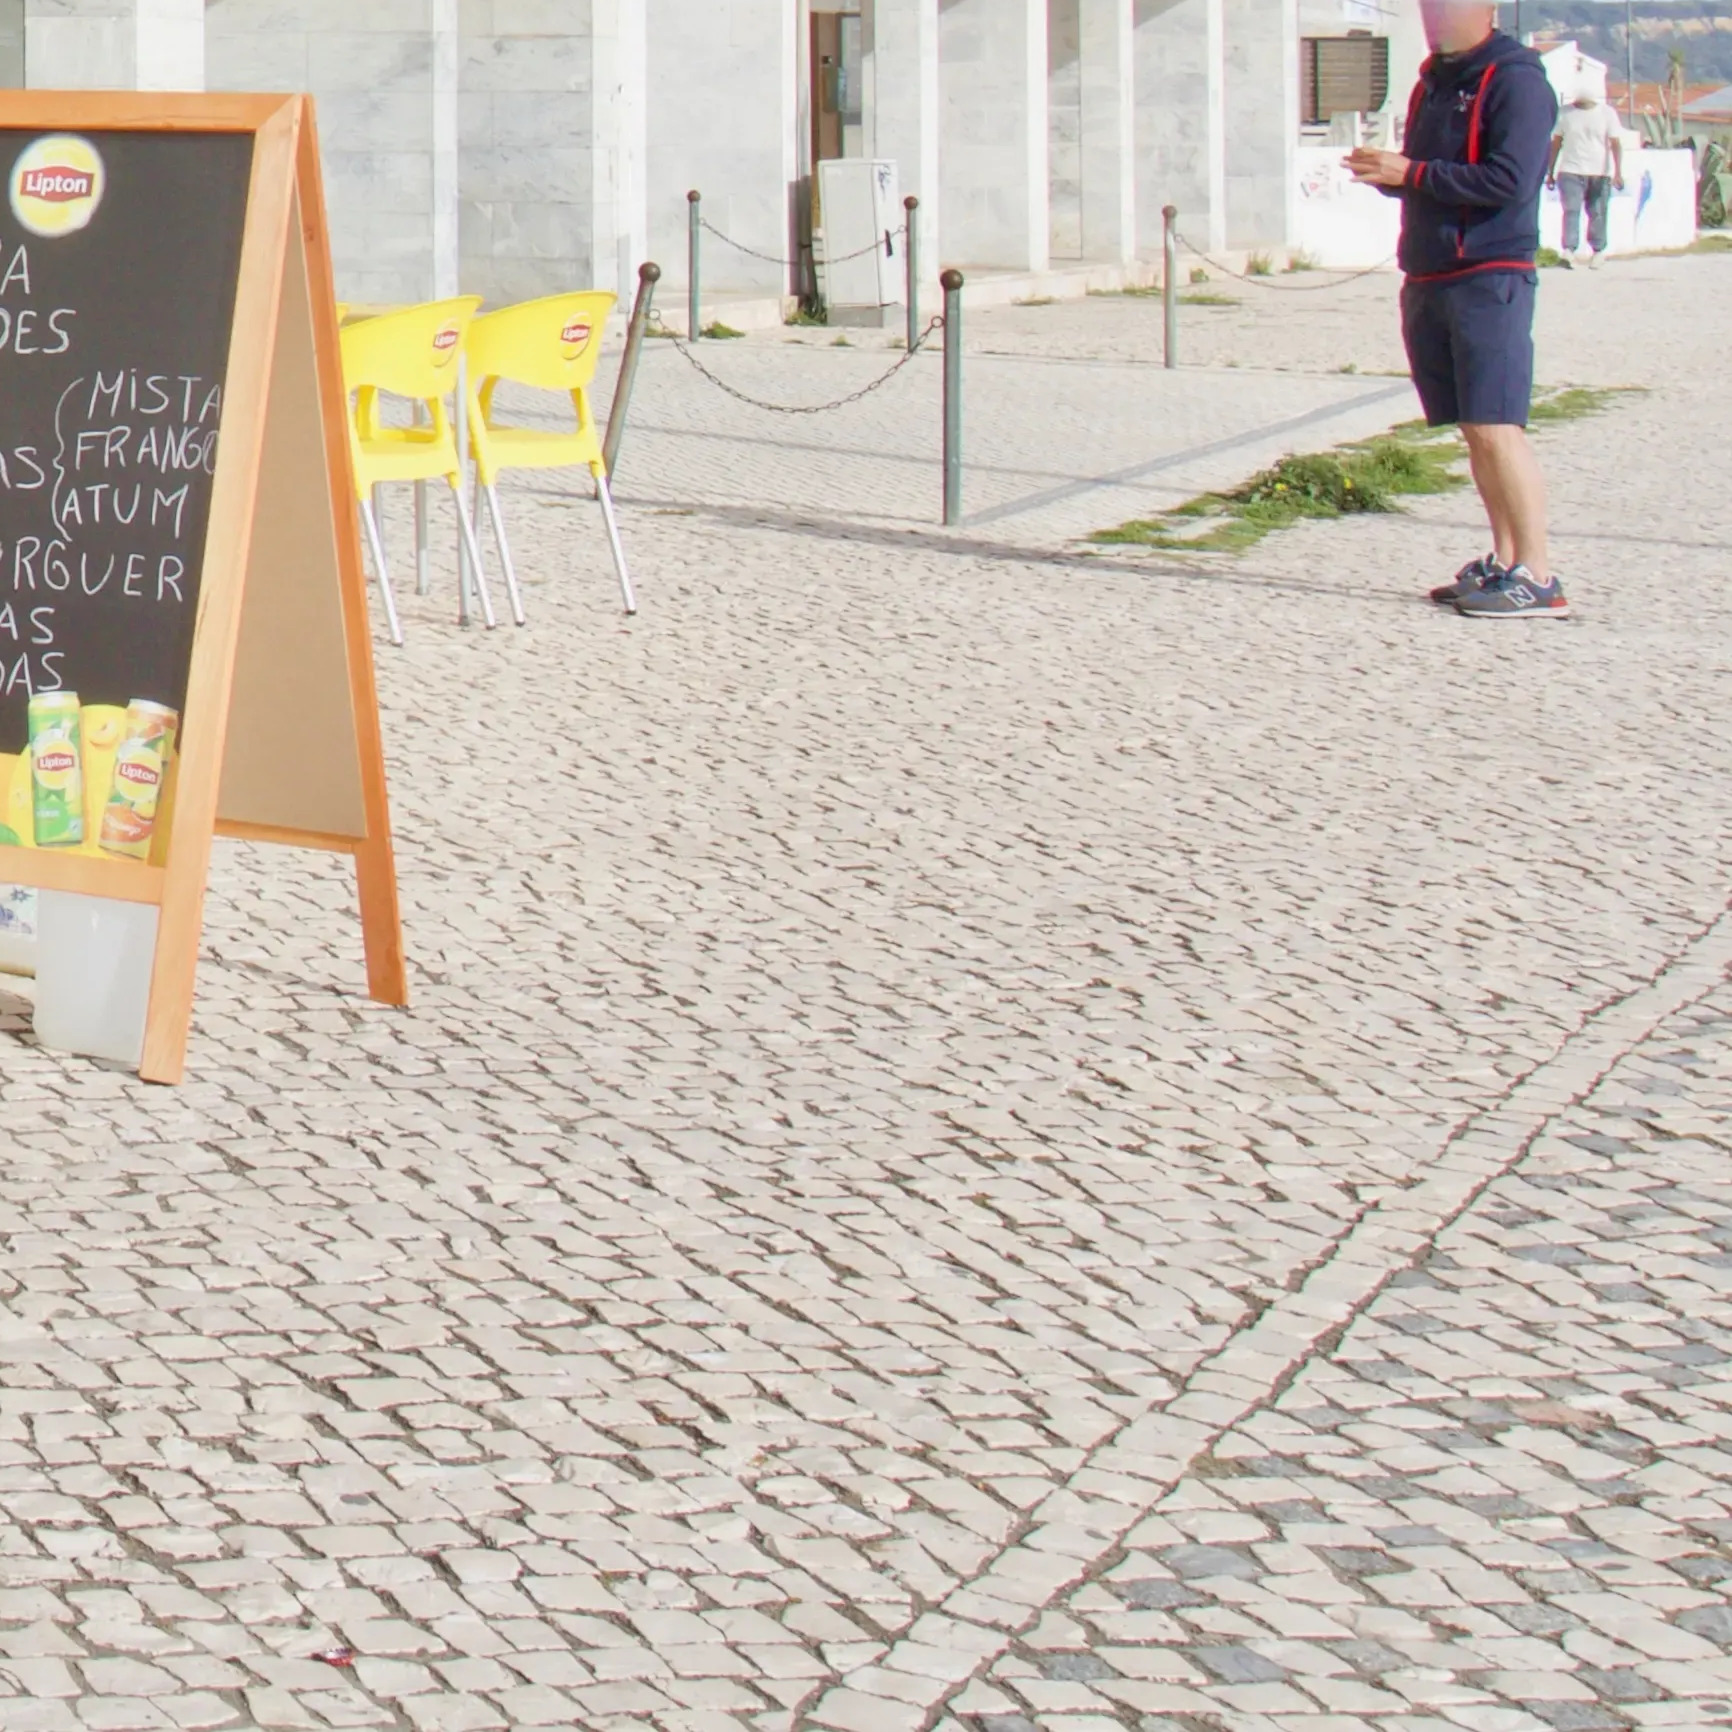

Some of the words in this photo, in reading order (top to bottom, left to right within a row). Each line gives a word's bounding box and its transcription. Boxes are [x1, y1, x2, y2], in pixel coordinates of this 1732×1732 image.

[25, 170, 88, 199] Lipton
[61, 486, 189, 536] ATUM
[40, 757, 72, 771] Lipton
[122, 765, 156, 782] Lipton
